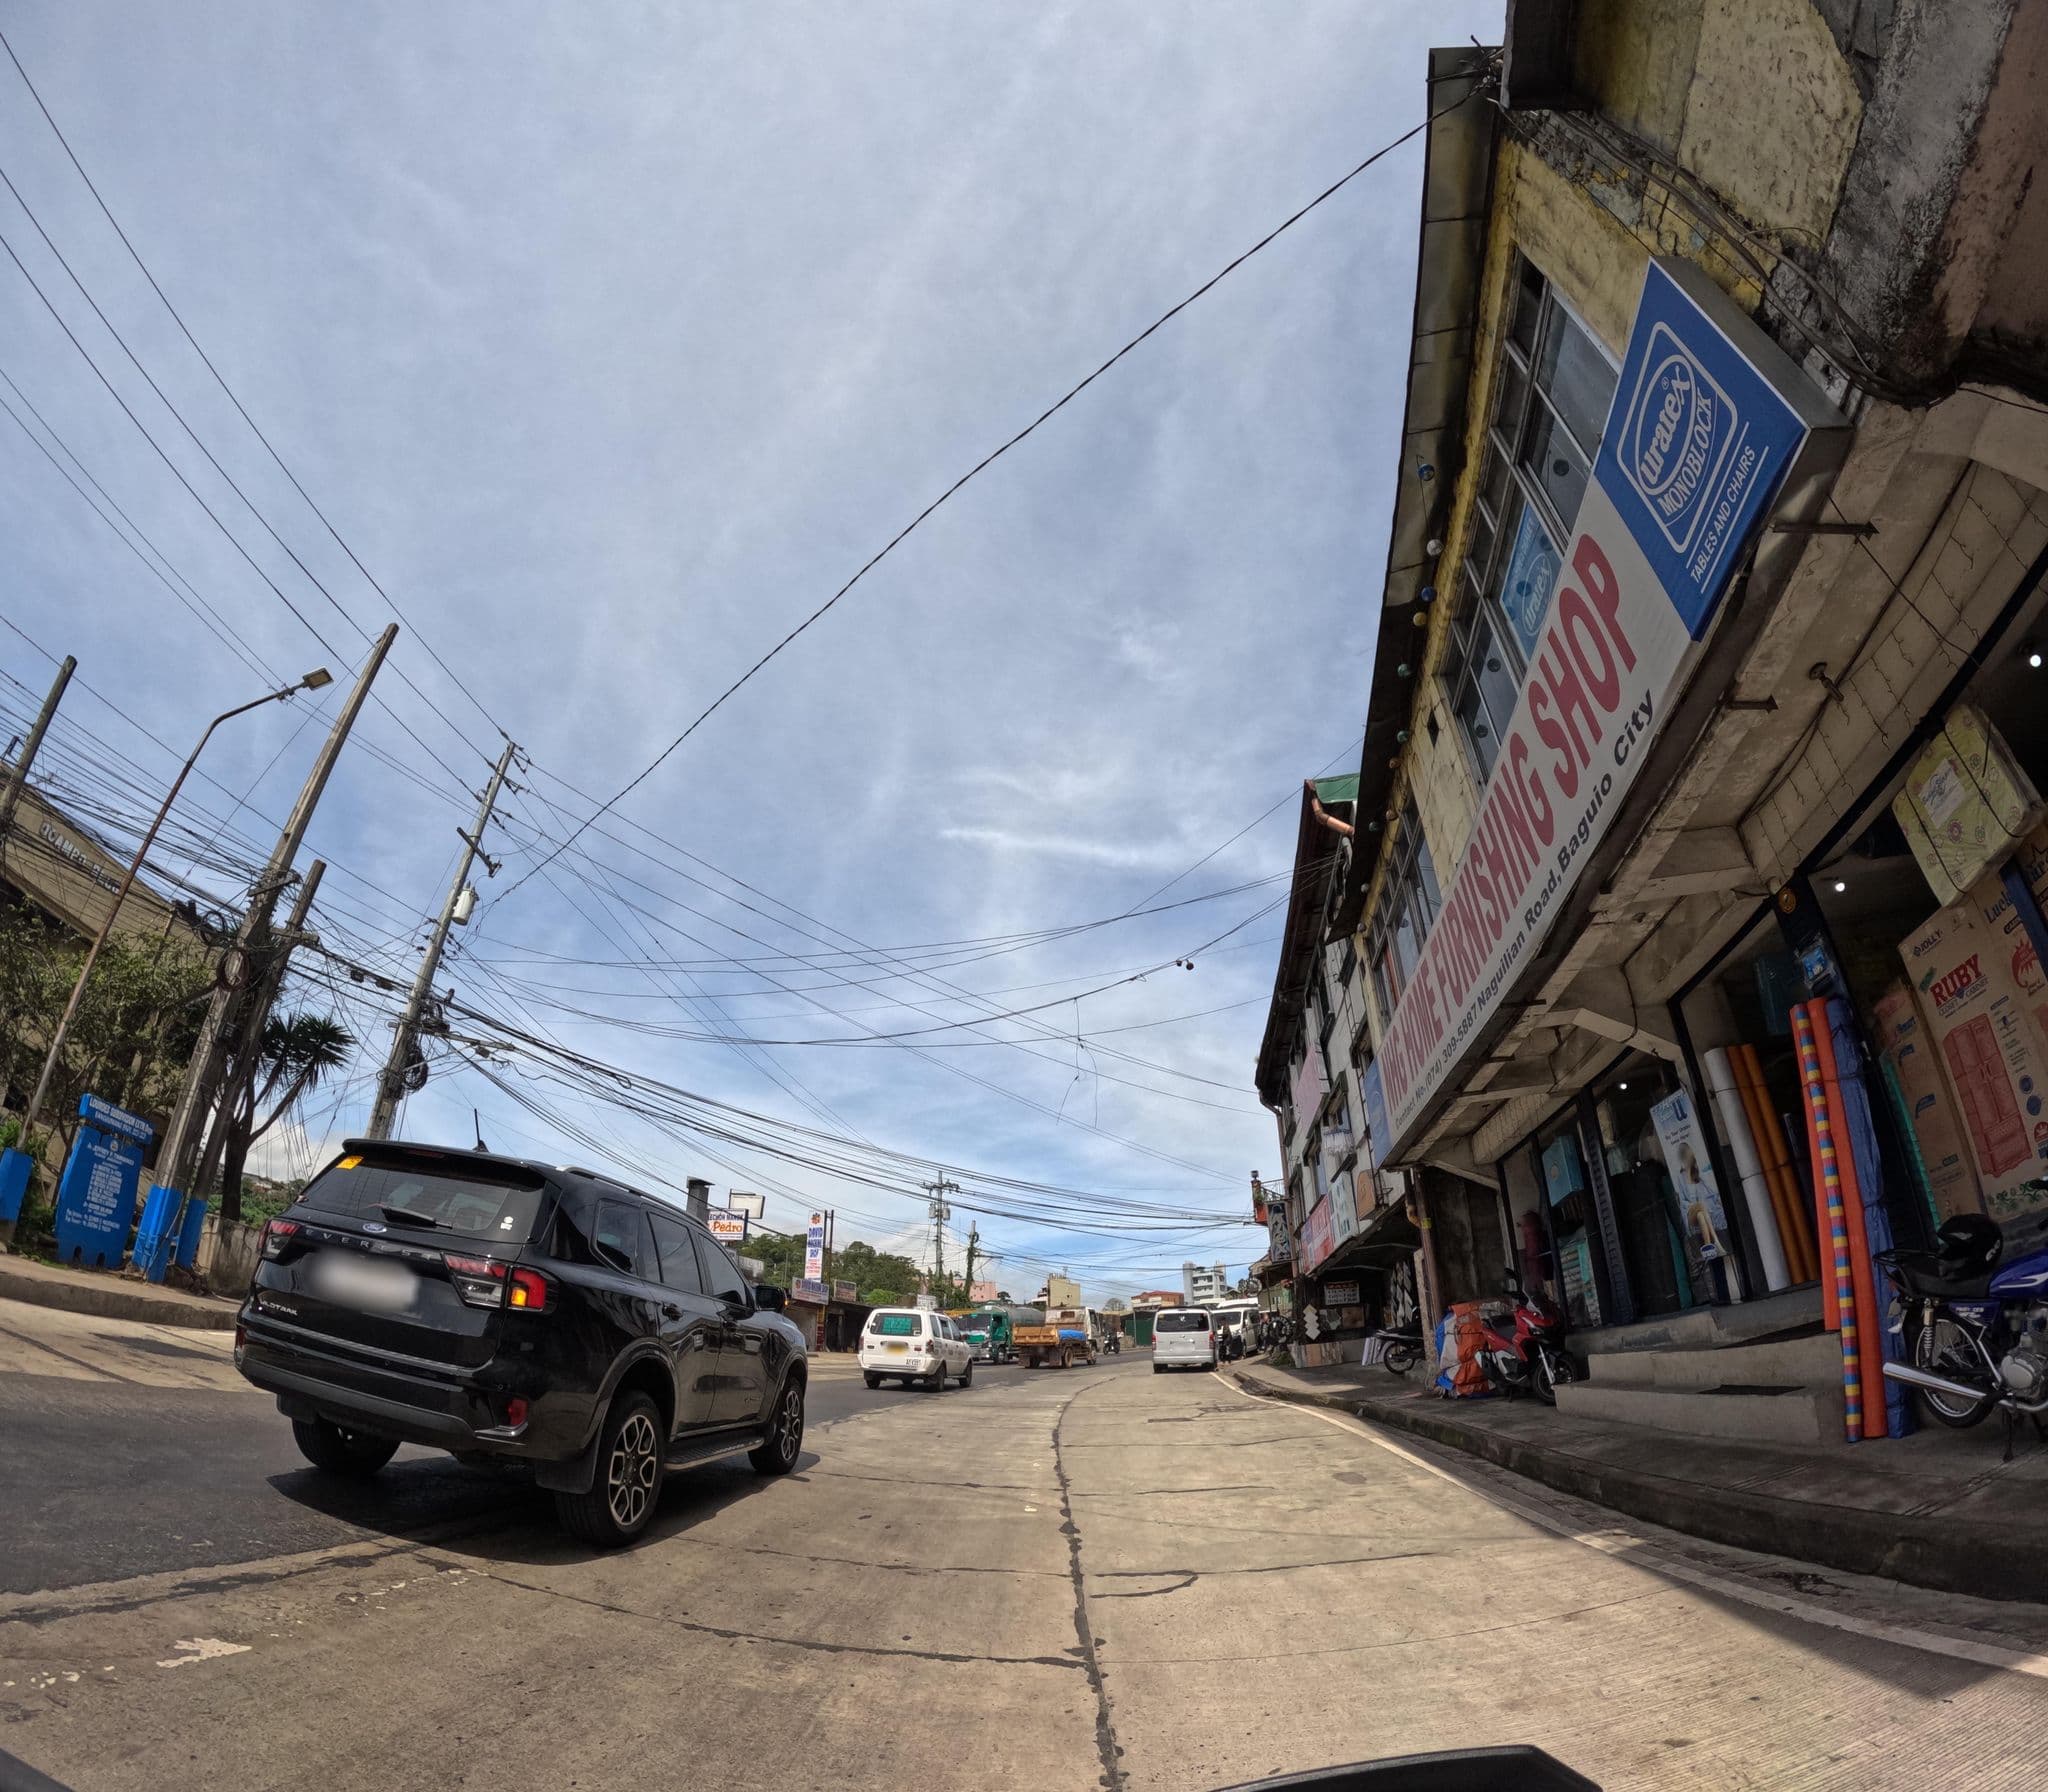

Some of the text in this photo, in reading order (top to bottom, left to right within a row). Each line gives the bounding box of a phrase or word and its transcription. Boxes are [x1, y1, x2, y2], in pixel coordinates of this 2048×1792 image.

[1657, 387, 1714, 518] MONOBLOCK
[1690, 444, 1757, 583] TABLES AND CHAIRS
[1400, 959, 1445, 1073] HOME
[1430, 731, 1555, 1026] FURNISHING
[1528, 533, 1638, 799] SHOP
[1425, 1060, 1443, 1092] (074)
[1442, 1008, 1480, 1065] 309-5887
[1476, 930, 1527, 1012] Naguilian
[1613, 688, 1655, 767] City
[1918, 929, 1943, 953] JOLLY
[1929, 954, 1983, 1008] RUBY
[304, 1228, 434, 1261] EVEREST
[713, 1220, 742, 1233] Pedro
